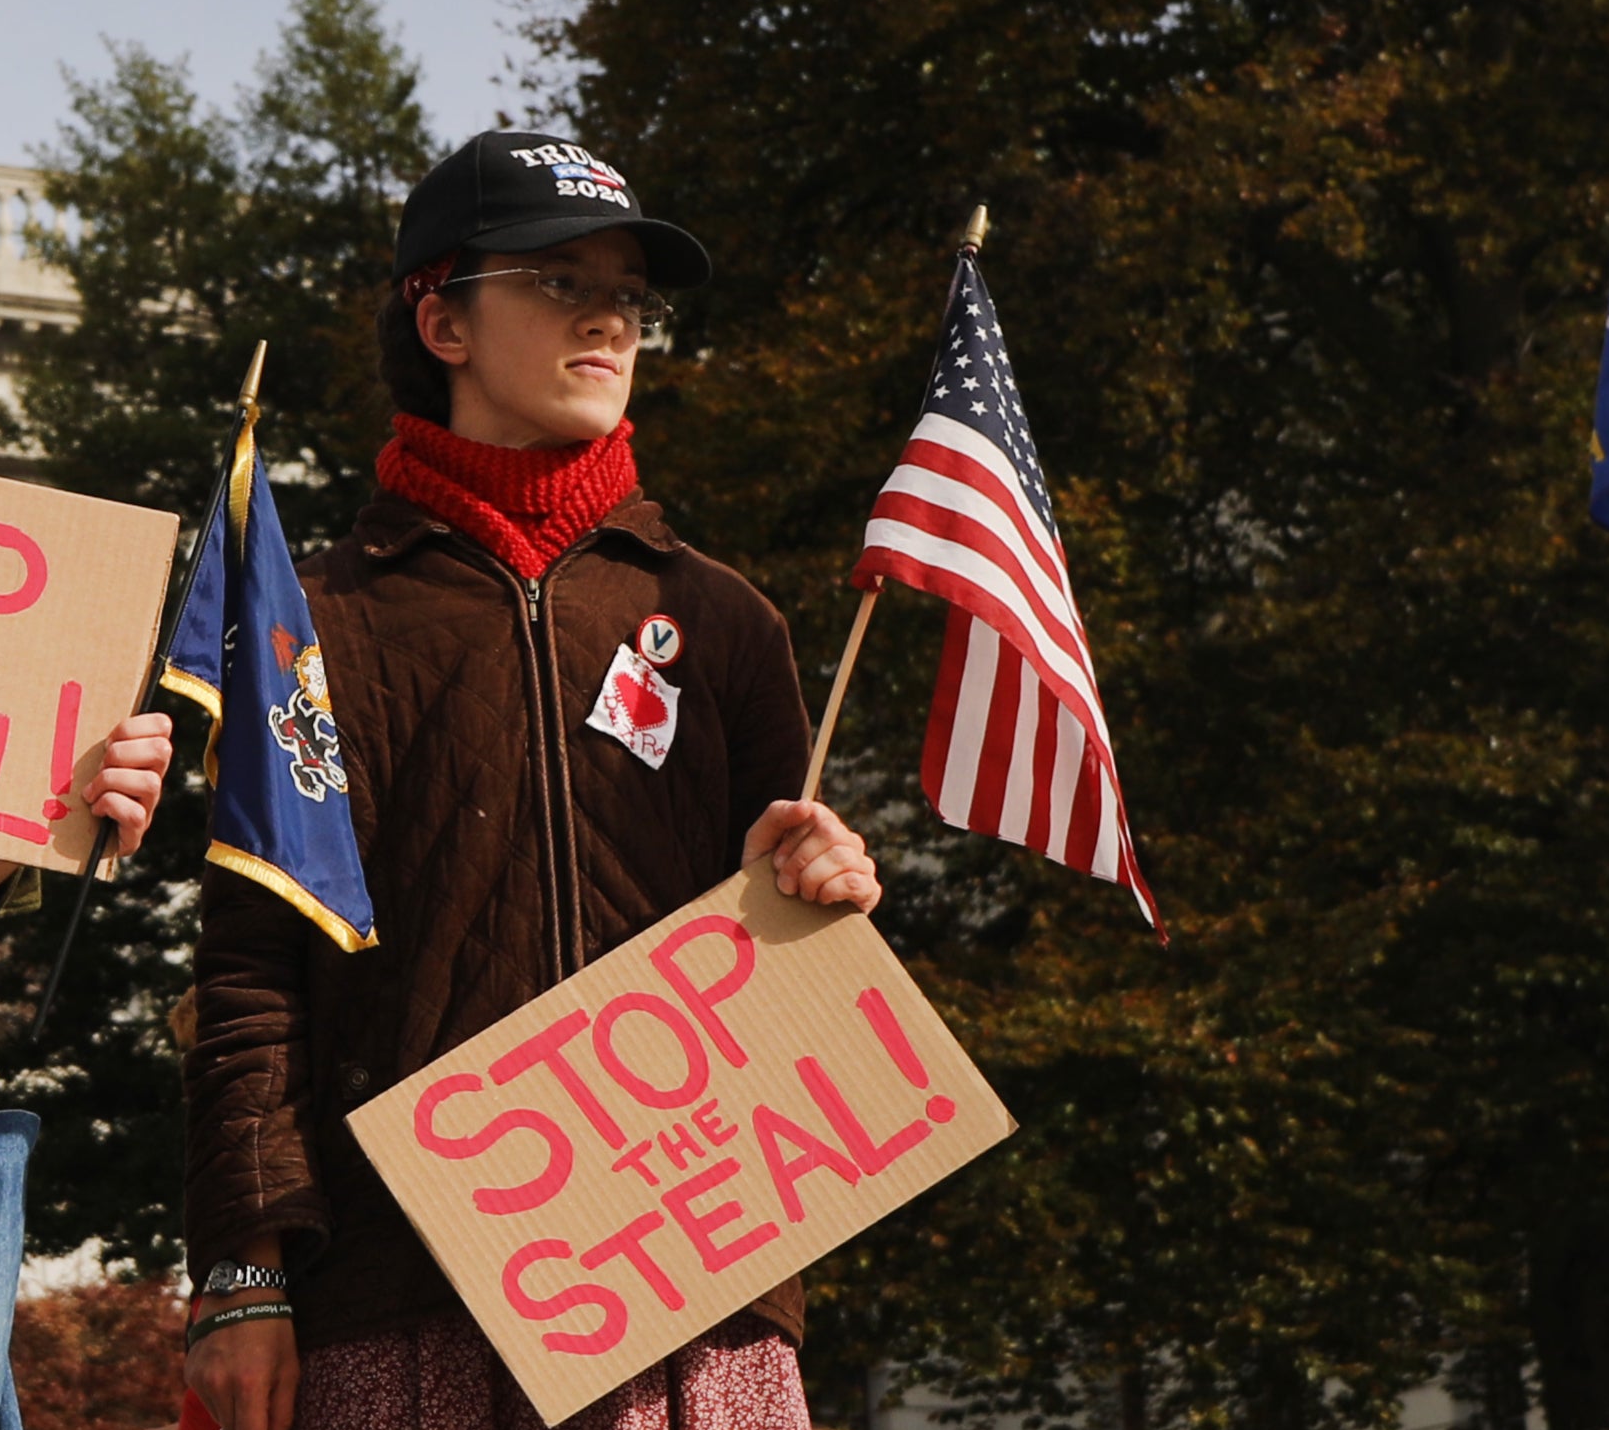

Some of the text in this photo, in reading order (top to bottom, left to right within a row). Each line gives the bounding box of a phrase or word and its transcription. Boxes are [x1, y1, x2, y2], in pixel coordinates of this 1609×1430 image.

[555, 180, 631, 209] 2020
[414, 914, 755, 1216] STOP
[501, 987, 956, 1356] STEAL!
[611, 1098, 738, 1188] THE
[214, 1308, 244, 1322] Serve
[247, 1304, 278, 1315] Honor
